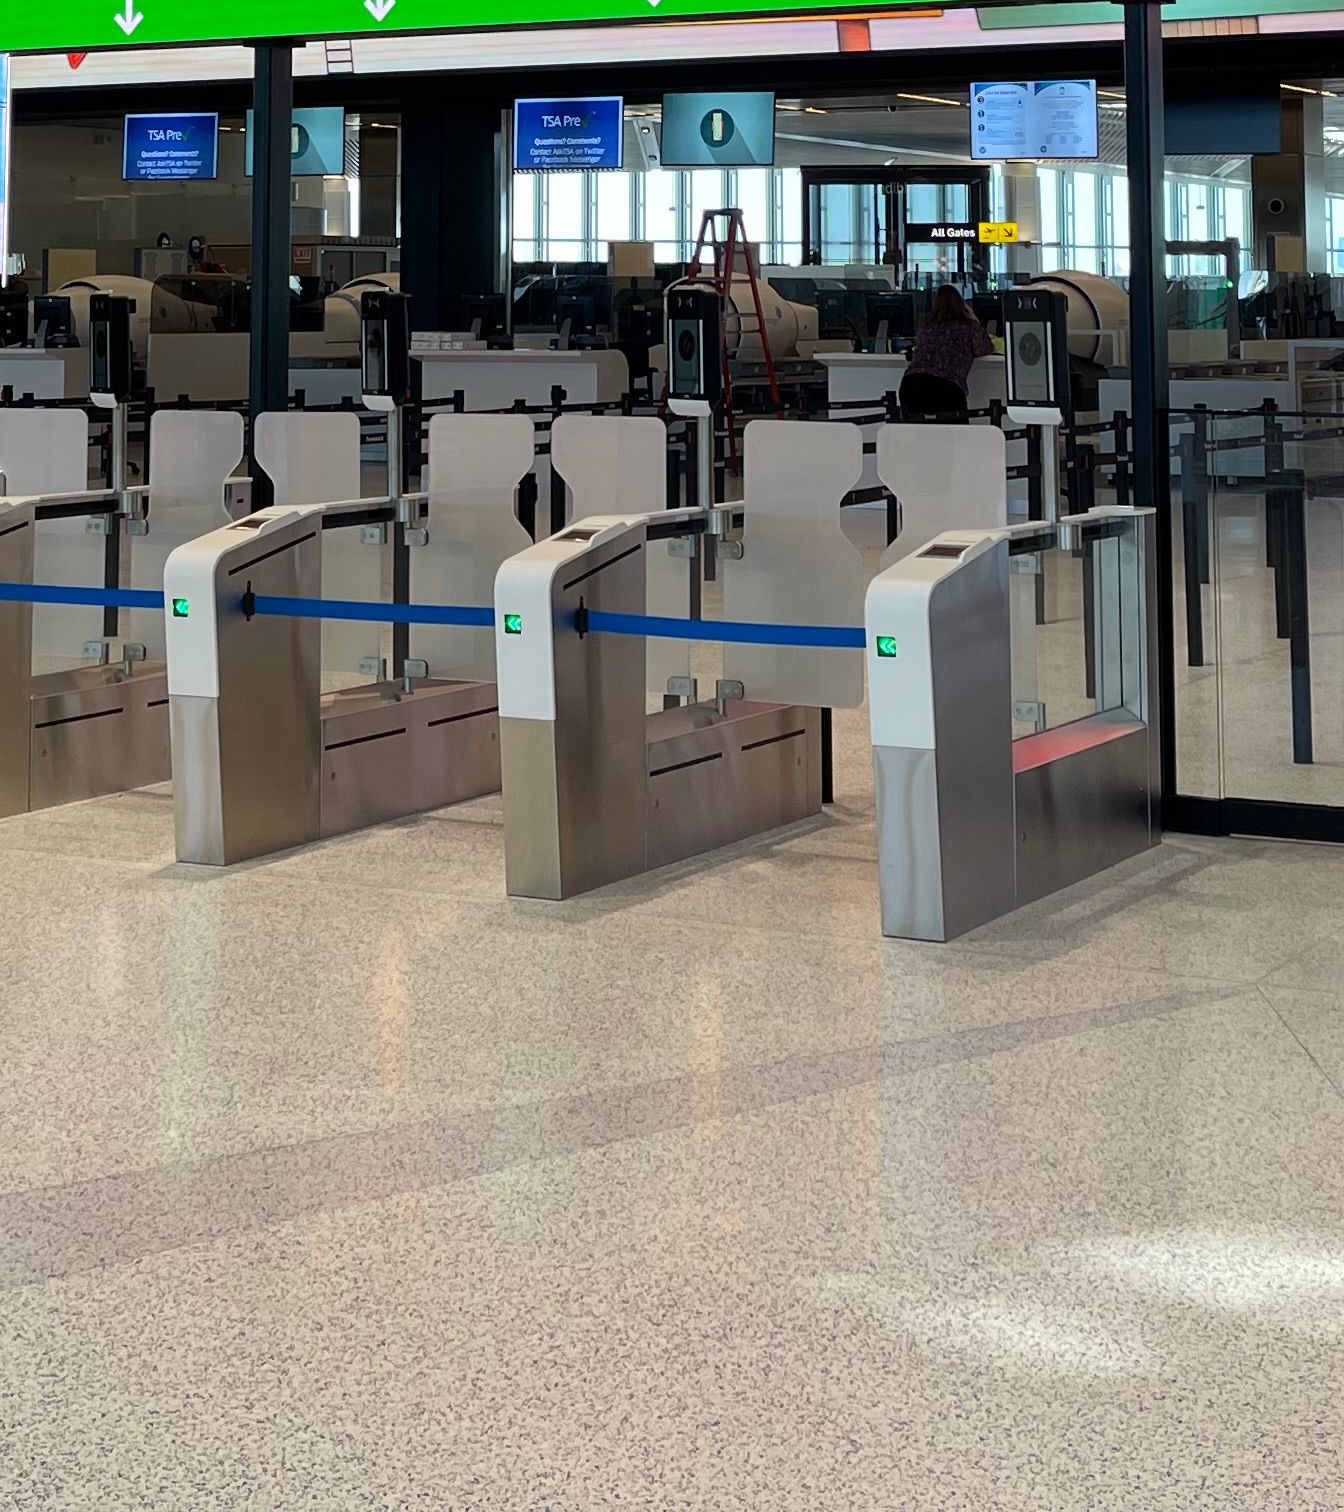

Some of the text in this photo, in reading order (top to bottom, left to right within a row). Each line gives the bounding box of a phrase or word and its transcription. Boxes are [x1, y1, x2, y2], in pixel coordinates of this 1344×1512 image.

[542, 115, 581, 127] TSA Pre
[148, 130, 165, 141] TSA
[931, 228, 976, 237] All Gates
